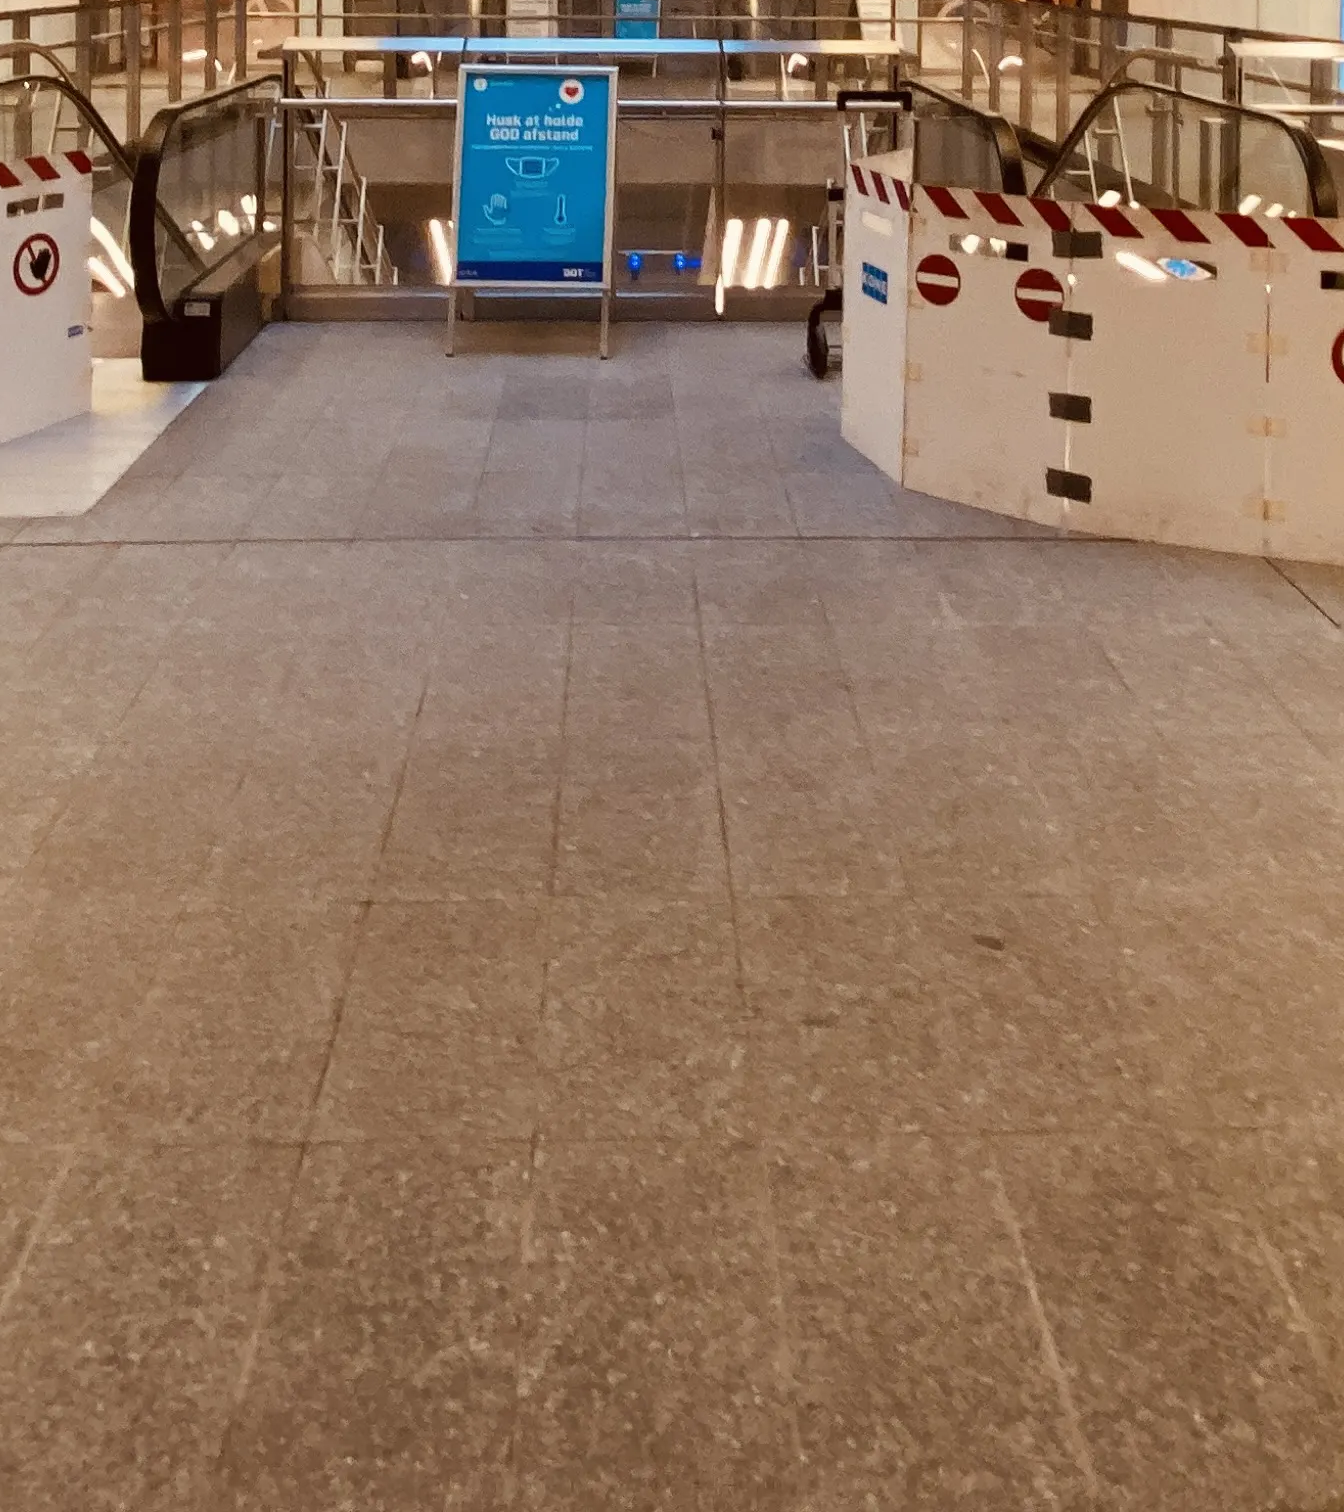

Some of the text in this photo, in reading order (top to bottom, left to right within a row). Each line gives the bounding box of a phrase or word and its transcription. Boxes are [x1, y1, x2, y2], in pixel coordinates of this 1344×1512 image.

[486, 113, 584, 128] Husk at holde
[489, 128, 579, 141] GOD afstand
